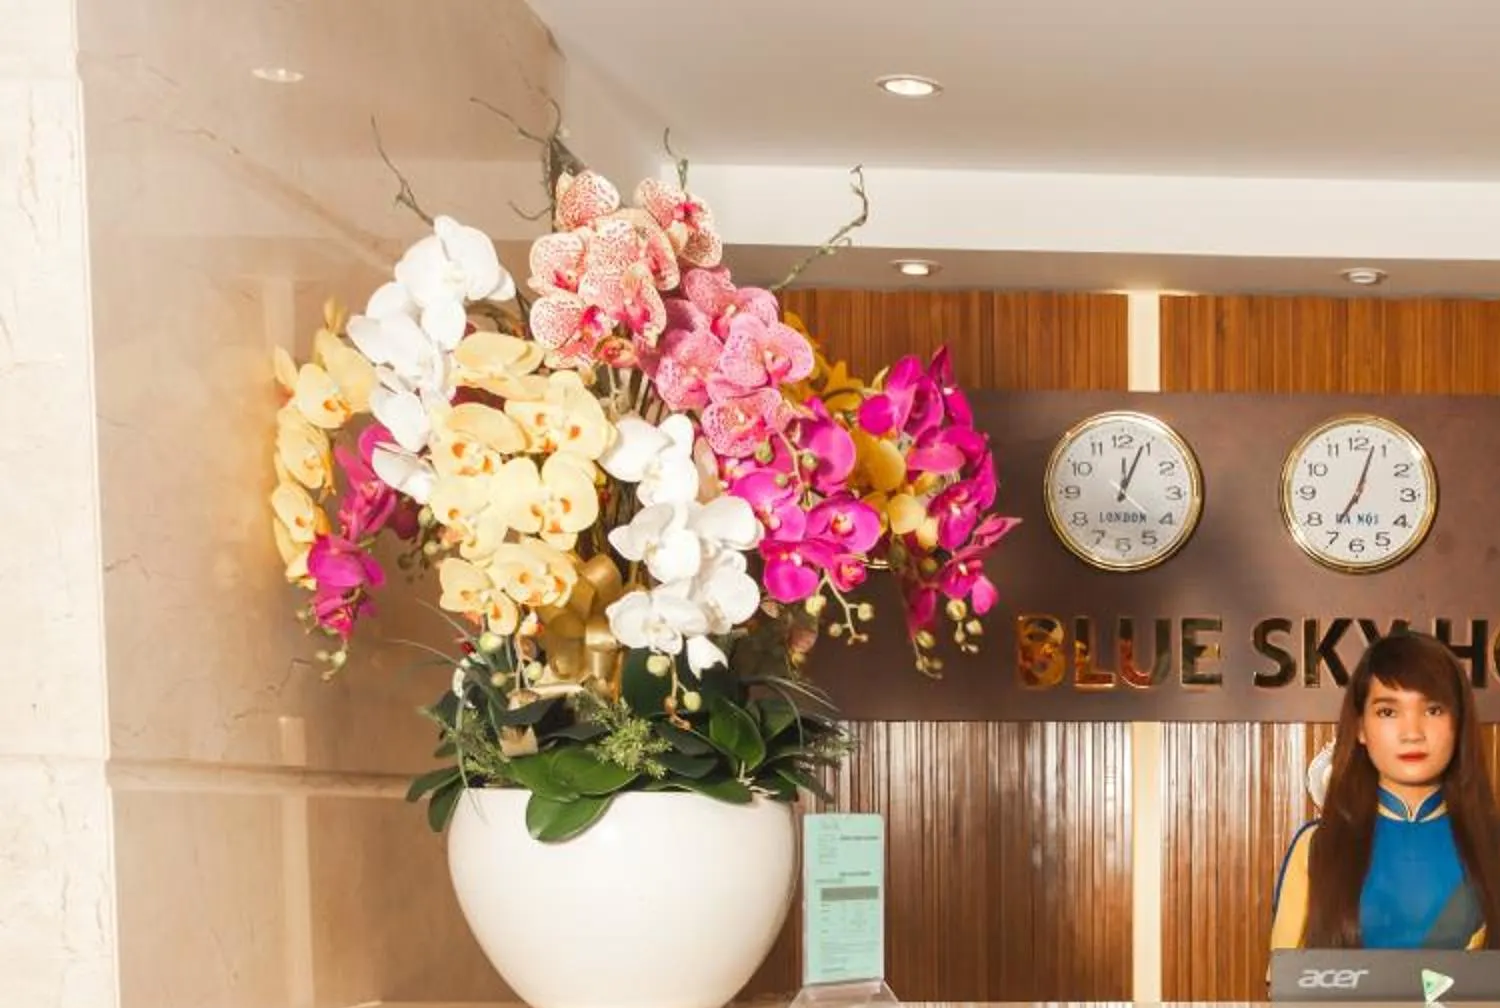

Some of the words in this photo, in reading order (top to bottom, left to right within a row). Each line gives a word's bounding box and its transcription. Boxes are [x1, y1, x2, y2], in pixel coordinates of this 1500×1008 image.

[1112, 435, 1134, 448] 12
[1349, 437, 1369, 451] 12
[1091, 442, 1102, 456] 11
[1328, 444, 1338, 456] 11
[1072, 462, 1092, 476] 10
[1159, 461, 1174, 475] 2
[1308, 463, 1328, 476] 10
[1394, 464, 1409, 477] 2
[1065, 485, 1080, 499] 9
[1166, 486, 1182, 500] 3
[1300, 486, 1316, 500] 9
[1400, 488, 1416, 502] 3
[1073, 512, 1088, 526] 8
[1100, 512, 1147, 523] LONDON
[1159, 512, 1173, 524] 4
[1308, 512, 1322, 526] 8
[1393, 515, 1406, 527] 4
[1092, 530, 1105, 544] 7
[1142, 531, 1157, 544] 5
[1327, 532, 1339, 545] 7
[1376, 532, 1391, 546] 5
[1115, 538, 1131, 552] 6
[1349, 539, 1364, 552] 6
[1017, 615, 1222, 688] BLUE
[1298, 969, 1369, 989] acer
